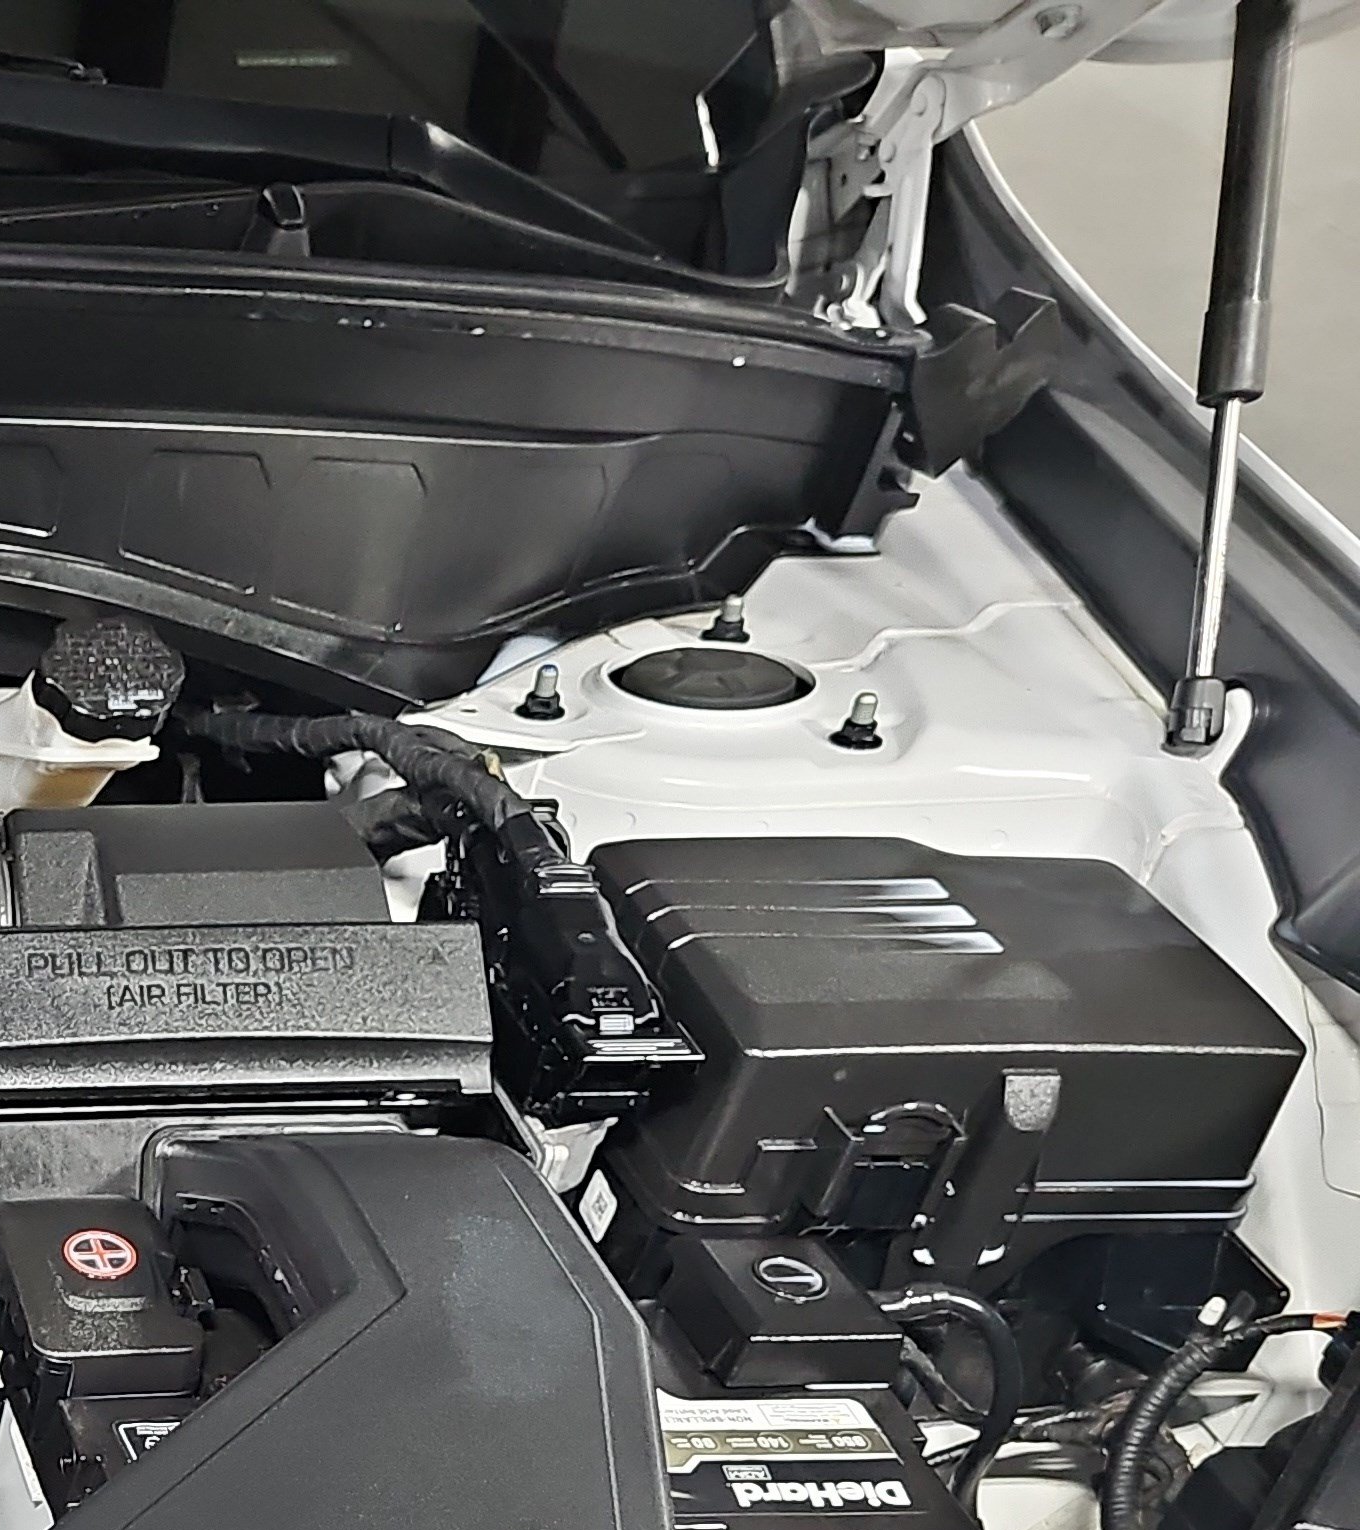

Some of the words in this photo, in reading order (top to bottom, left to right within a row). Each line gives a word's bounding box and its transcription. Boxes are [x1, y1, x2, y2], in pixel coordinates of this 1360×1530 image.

[26, 951, 118, 977] PULL
[126, 948, 197, 975] OUT
[207, 947, 252, 974] TO
[262, 947, 356, 974] OPEN
[730, 1480, 913, 1508] DieHard
